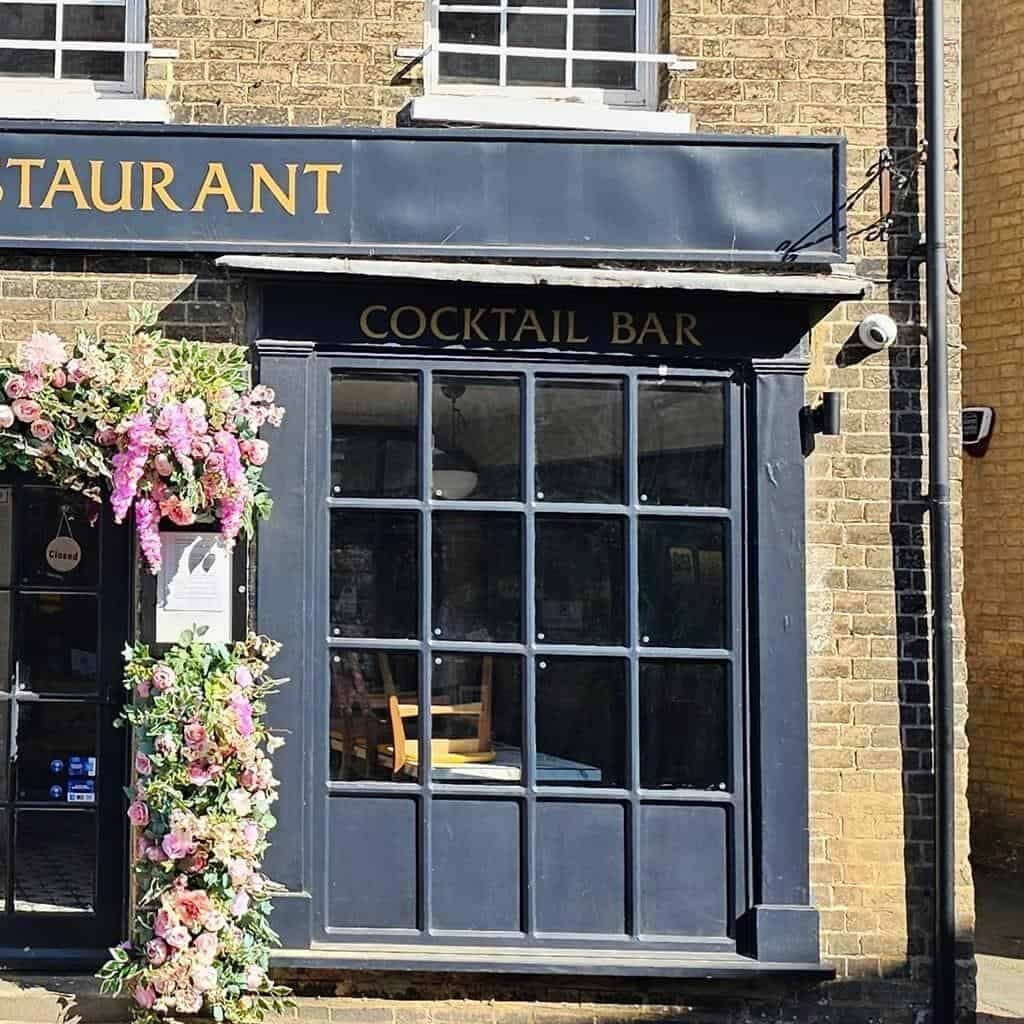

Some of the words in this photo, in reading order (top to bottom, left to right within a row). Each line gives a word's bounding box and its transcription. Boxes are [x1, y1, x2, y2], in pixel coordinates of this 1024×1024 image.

[359, 304, 589, 345] COCKTAIL
[609, 311, 703, 347] BAR
[48, 550, 79, 561] Closed
